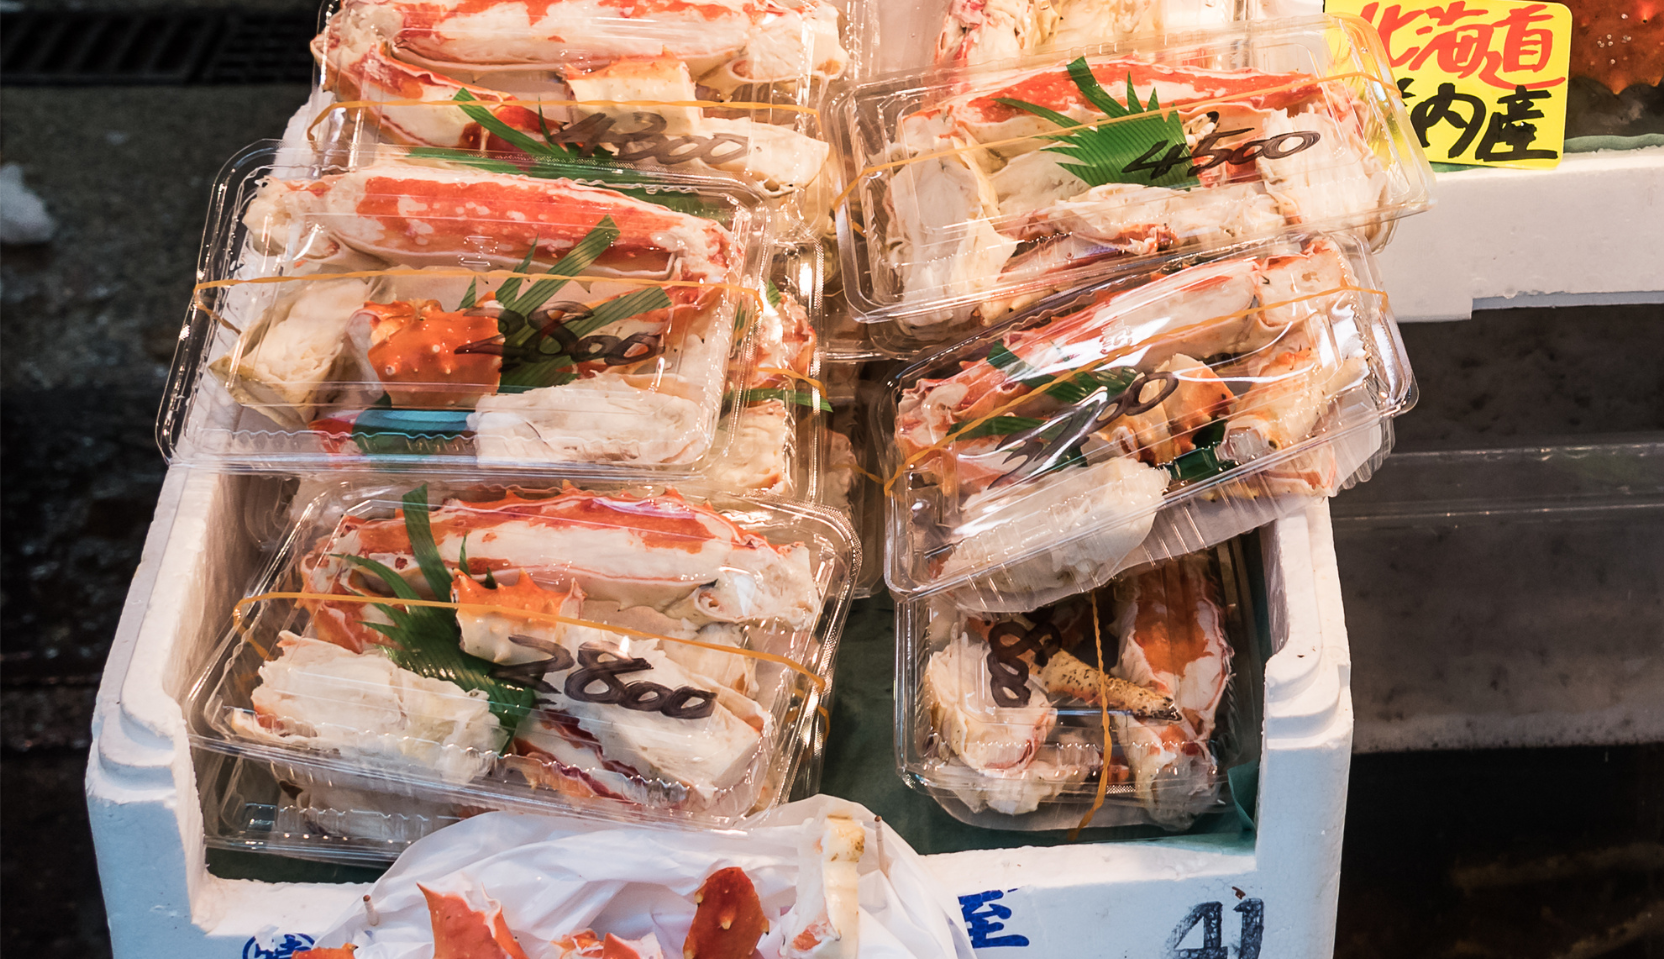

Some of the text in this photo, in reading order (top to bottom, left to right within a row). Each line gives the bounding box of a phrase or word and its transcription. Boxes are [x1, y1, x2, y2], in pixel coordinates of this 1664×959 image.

[1360, 0, 1566, 90] 北海道
[1397, 77, 1559, 162] 内産
